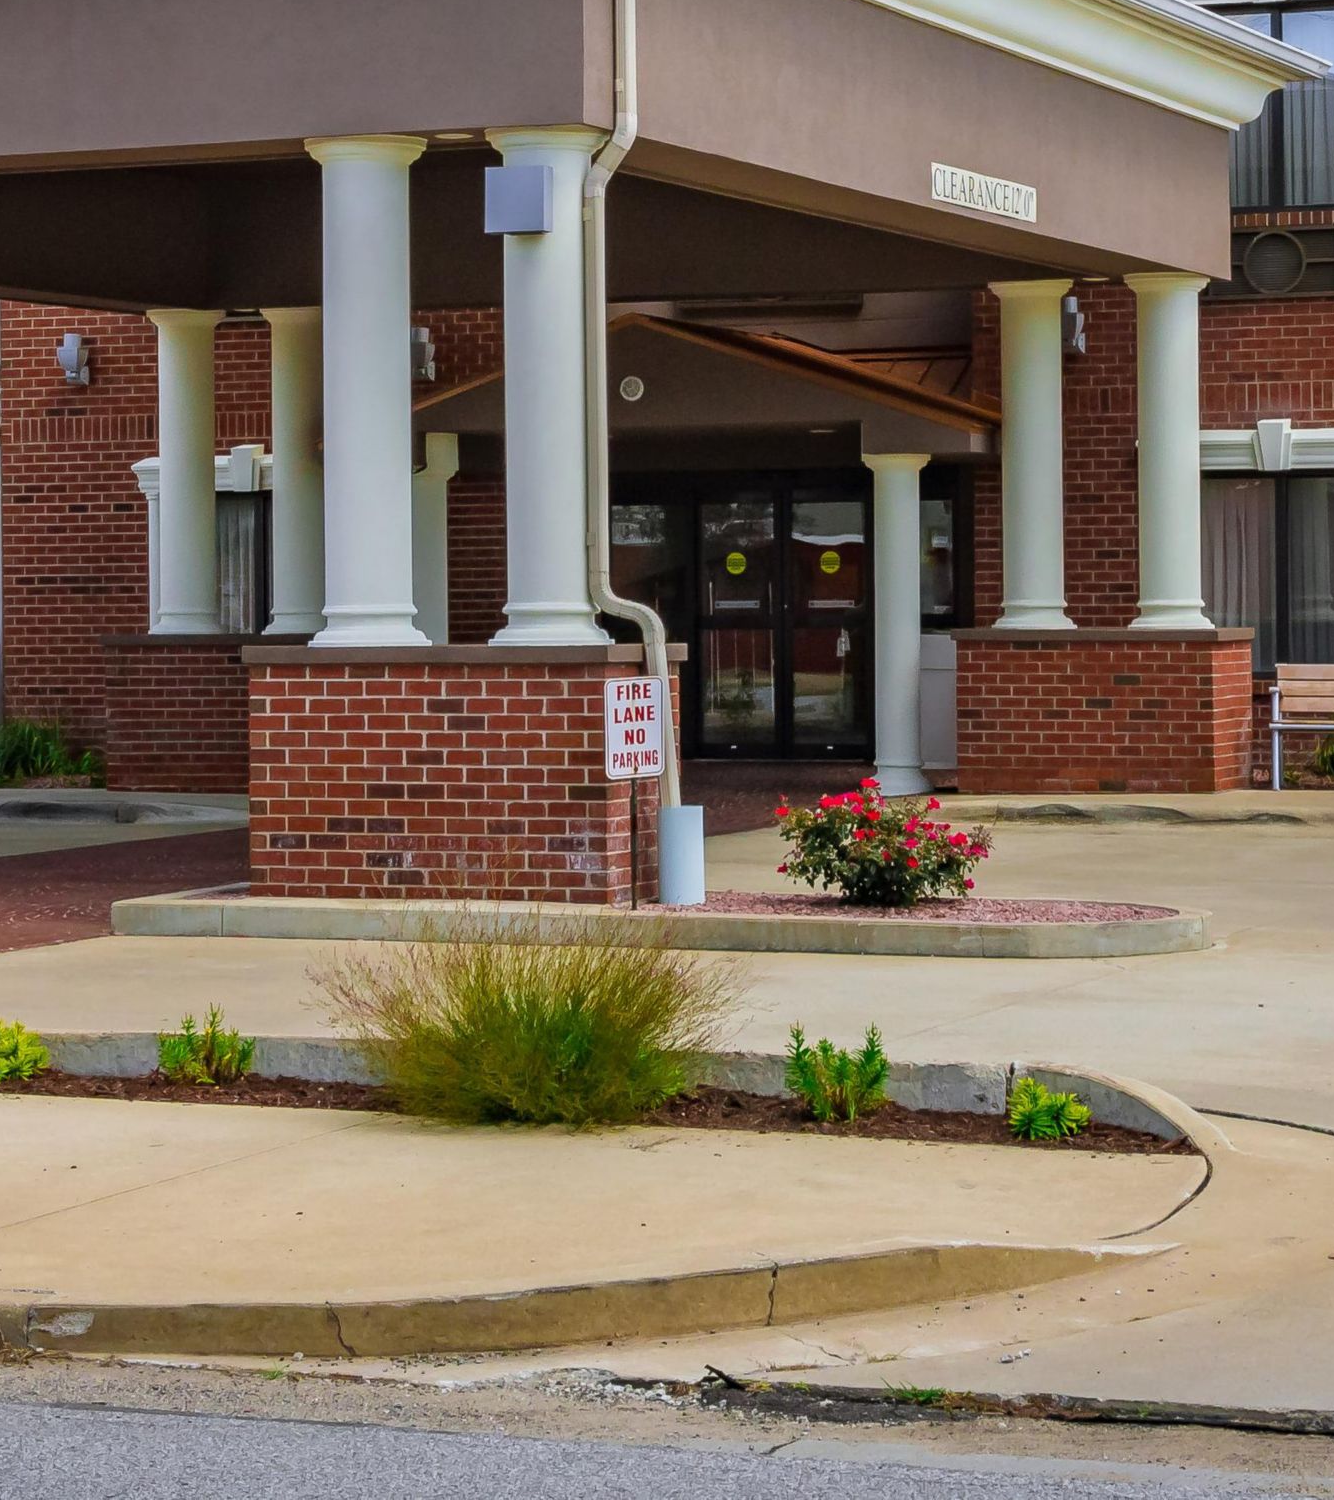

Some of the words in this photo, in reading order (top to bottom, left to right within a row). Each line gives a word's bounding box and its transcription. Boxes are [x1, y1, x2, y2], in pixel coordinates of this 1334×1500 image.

[933, 167, 1010, 212] CLEARANCE
[616, 683, 652, 701] FIRE
[614, 705, 656, 724] LANE
[624, 728, 646, 745] NO
[612, 749, 659, 769] PARKING
